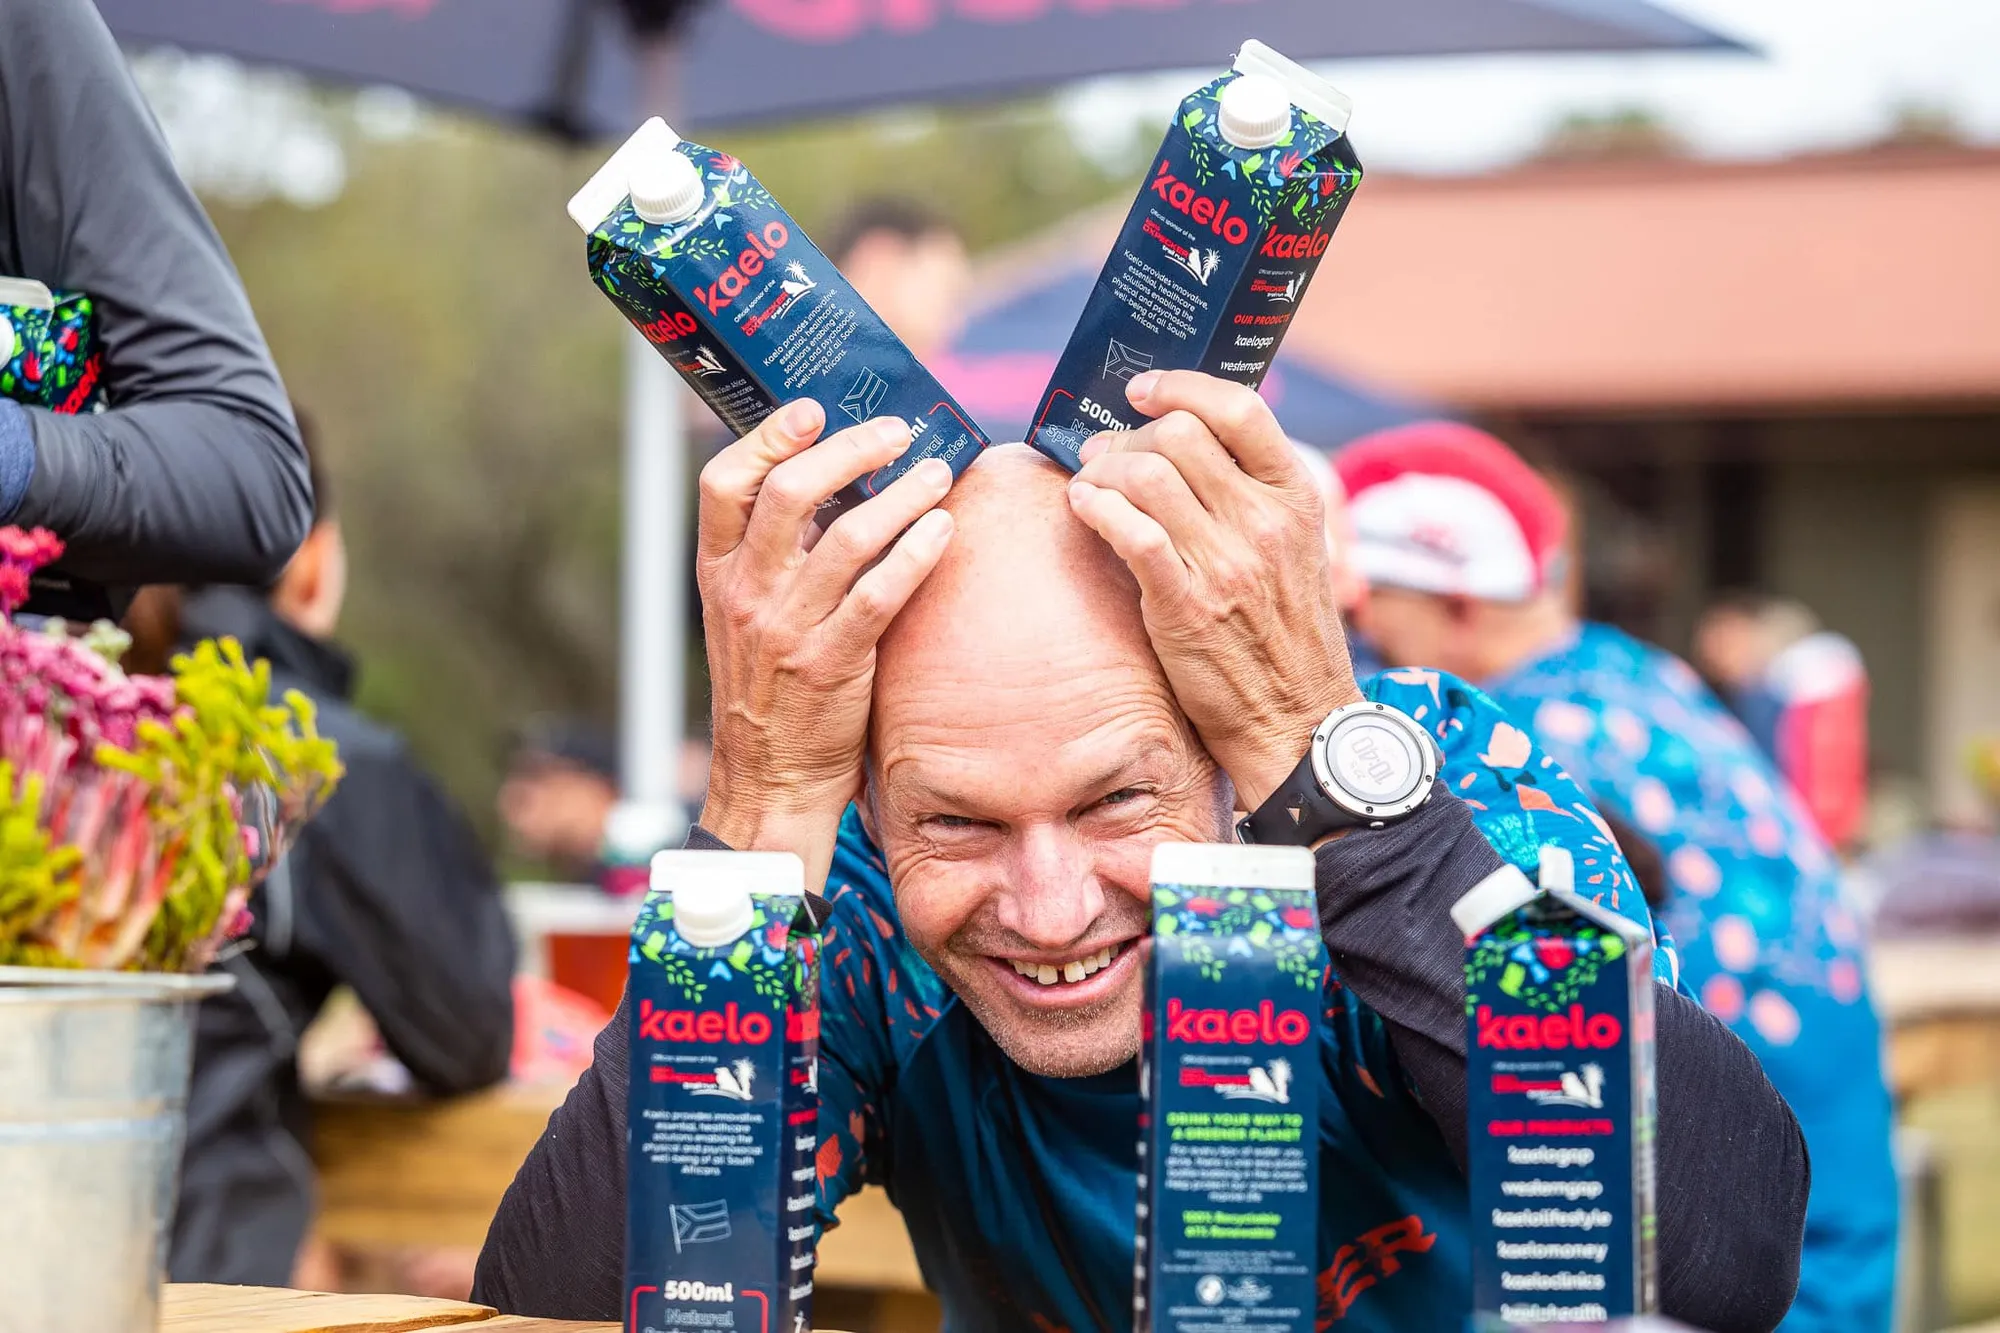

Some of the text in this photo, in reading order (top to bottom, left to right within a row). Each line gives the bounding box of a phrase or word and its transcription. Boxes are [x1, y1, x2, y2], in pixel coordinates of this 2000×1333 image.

[1151, 160, 1248, 245] kaelo
[1142, 224, 1189, 258] OXPECKER
[1260, 225, 1328, 258] kaelo
[692, 220, 789, 316] kaelo
[1124, 250, 1142, 266] Kaelo
[1142, 264, 1171, 286] provides
[734, 306, 750, 323] Official
[749, 292, 764, 308] sponsor
[746, 292, 789, 336] OXPECKER
[771, 298, 792, 320] trail run
[1112, 277, 1197, 335] physical and psychosocial
[1114, 289, 1186, 340] well-being of all South
[1122, 273, 1194, 322] solutions enabling the
[1158, 284, 1195, 312] healthcare
[632, 310, 697, 344] kaelo
[806, 303, 836, 337] healthcare
[1234, 313, 1290, 326] OUR PRODUCTS
[763, 346, 784, 366] Kaelo
[783, 320, 808, 348] provides
[784, 308, 844, 374] solutions enabling the
[784, 308, 857, 389] physical and psychosocial
[796, 321, 859, 389] well-being of all South
[1234, 334, 1274, 350] kaelogap
[1220, 360, 1266, 373] westerngap
[941, 434, 968, 461] ater
[1352, 736, 1394, 786] 10:40
[639, 999, 772, 1044] kaelo
[1167, 998, 1310, 1045] kaelo
[1476, 1003, 1622, 1050] kaelo
[1508, 1144, 1594, 1168] kaelogap
[664, 1280, 734, 1302] 500ml
[664, 1308, 734, 1328] Natural
